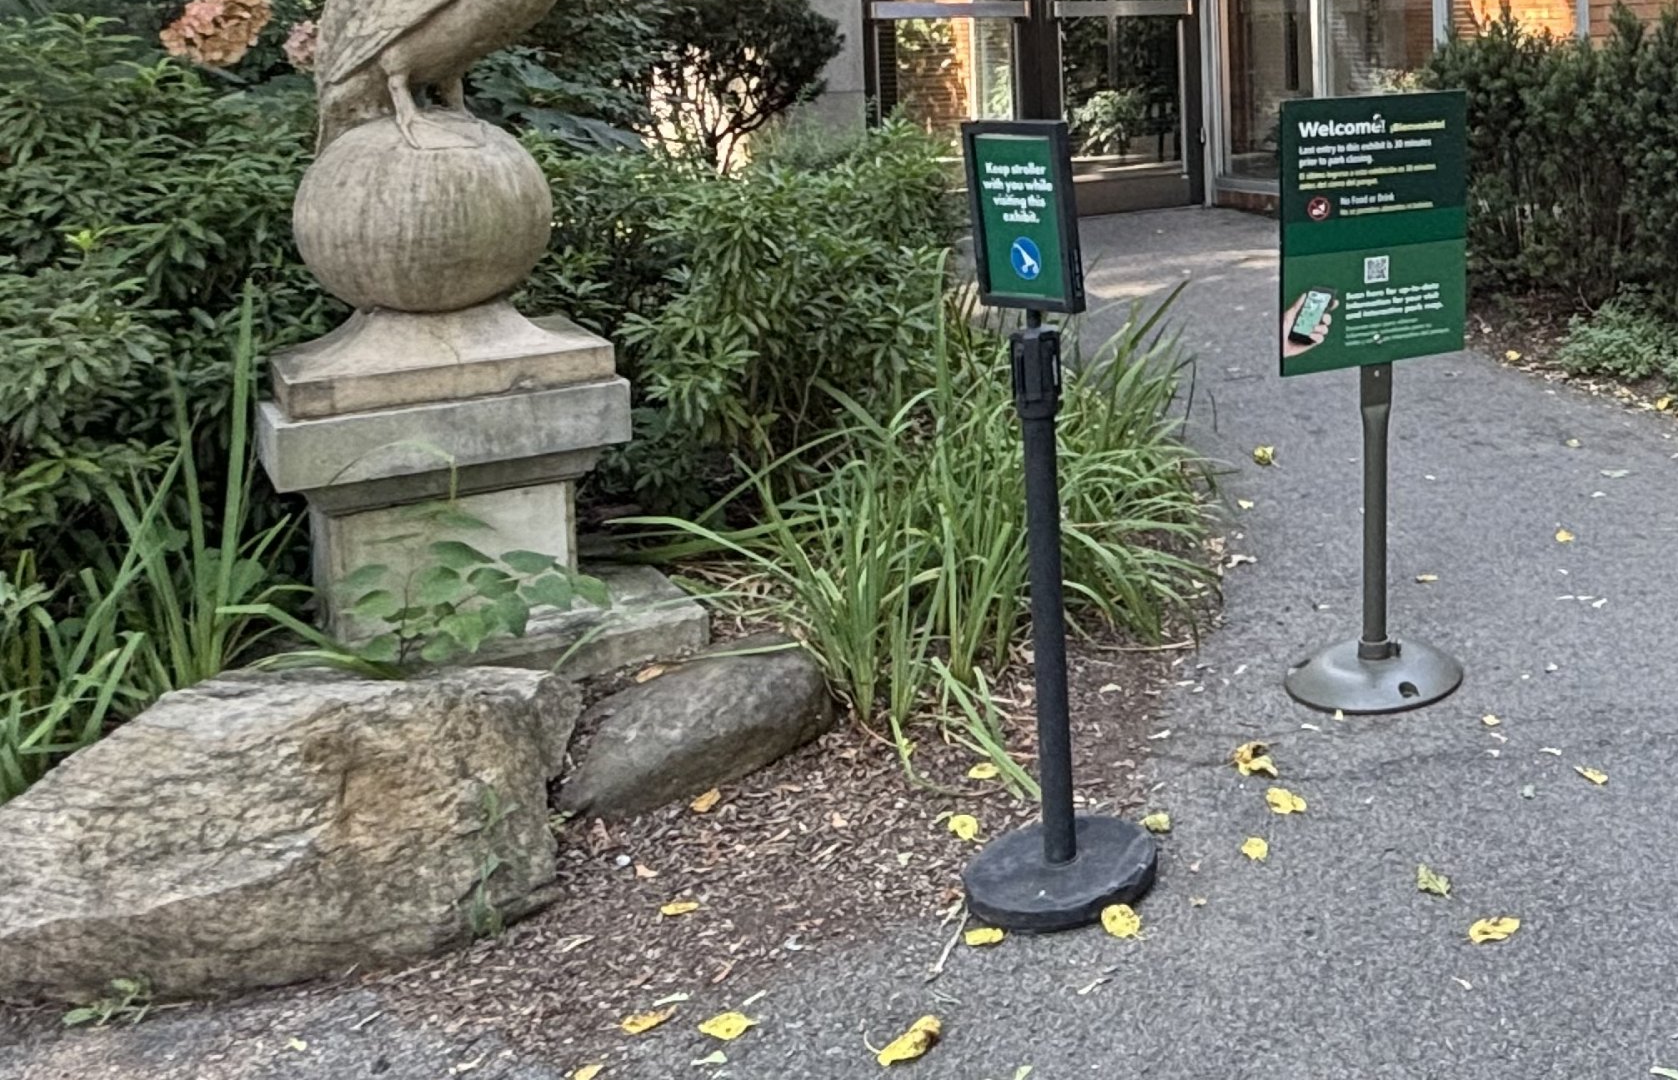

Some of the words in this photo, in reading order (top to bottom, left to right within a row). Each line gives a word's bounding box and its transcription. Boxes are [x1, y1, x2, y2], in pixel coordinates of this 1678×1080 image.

[1298, 119, 1386, 138] Welcome!
[984, 161, 1009, 177] Keep
[1010, 161, 1046, 176] stroller
[982, 177, 1004, 191] with
[1005, 180, 1024, 193] you
[1024, 177, 1053, 192] while
[992, 193, 1027, 209] visiting
[1027, 194, 1046, 208] this
[1002, 210, 1040, 224] exhibit.
